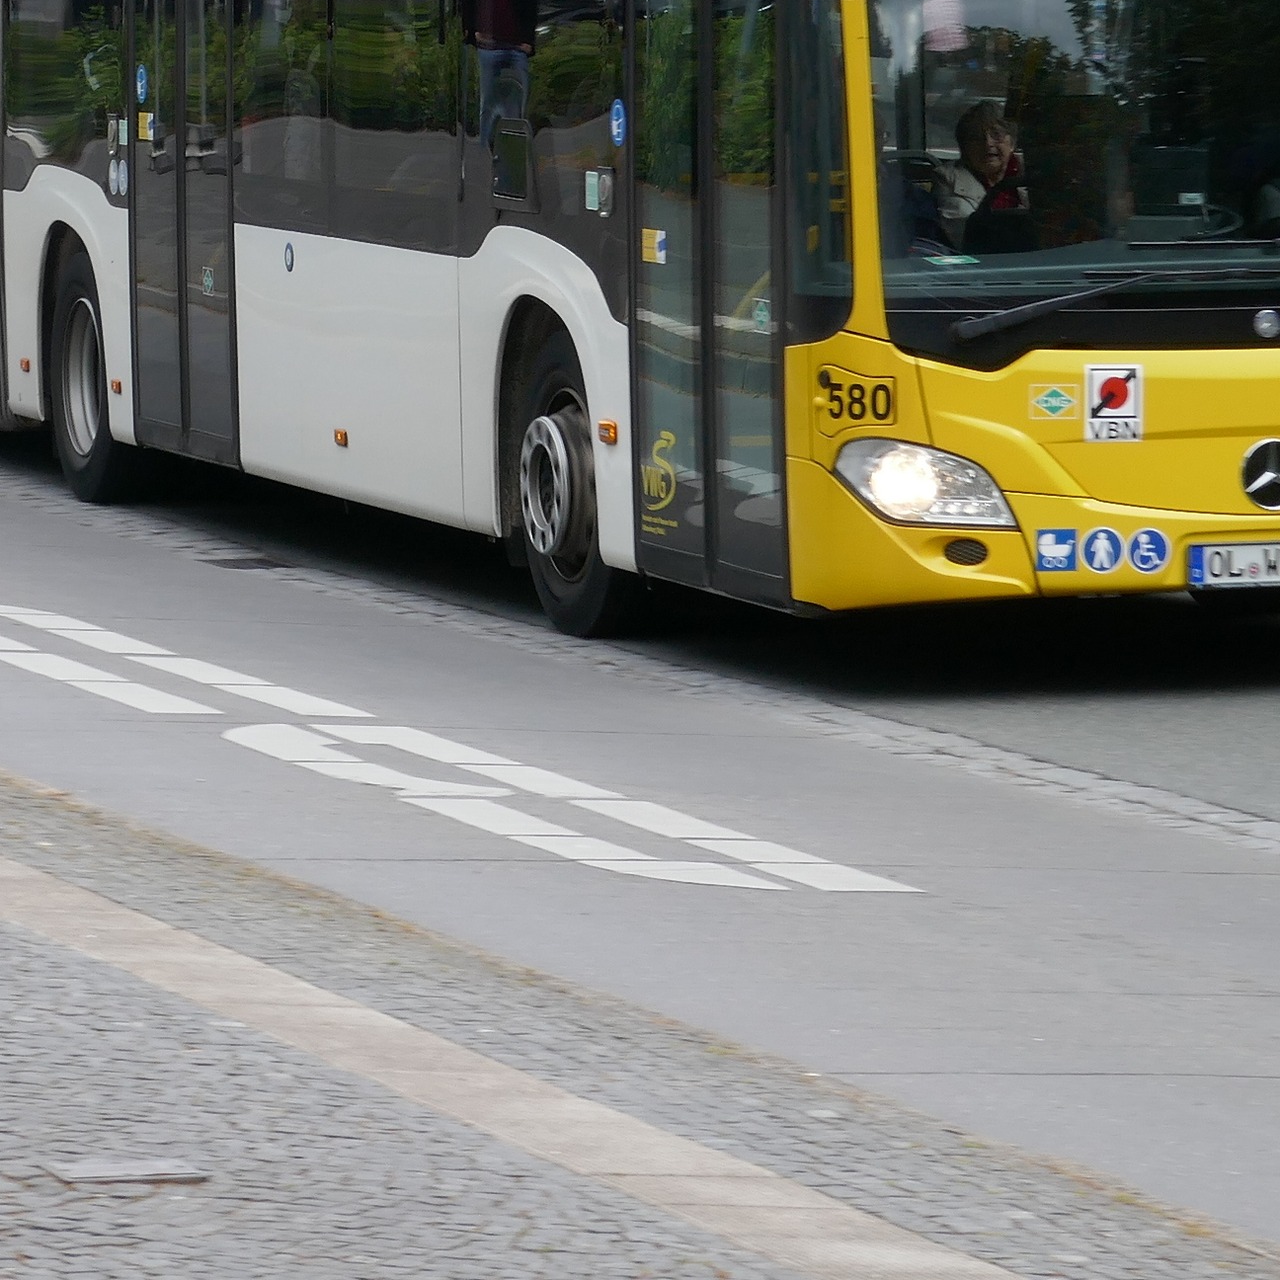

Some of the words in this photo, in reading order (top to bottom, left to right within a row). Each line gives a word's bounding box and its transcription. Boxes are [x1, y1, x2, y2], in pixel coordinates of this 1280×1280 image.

[828, 382, 892, 421] 580
[1089, 421, 1139, 440] VBN
[1209, 550, 1244, 578] OL
